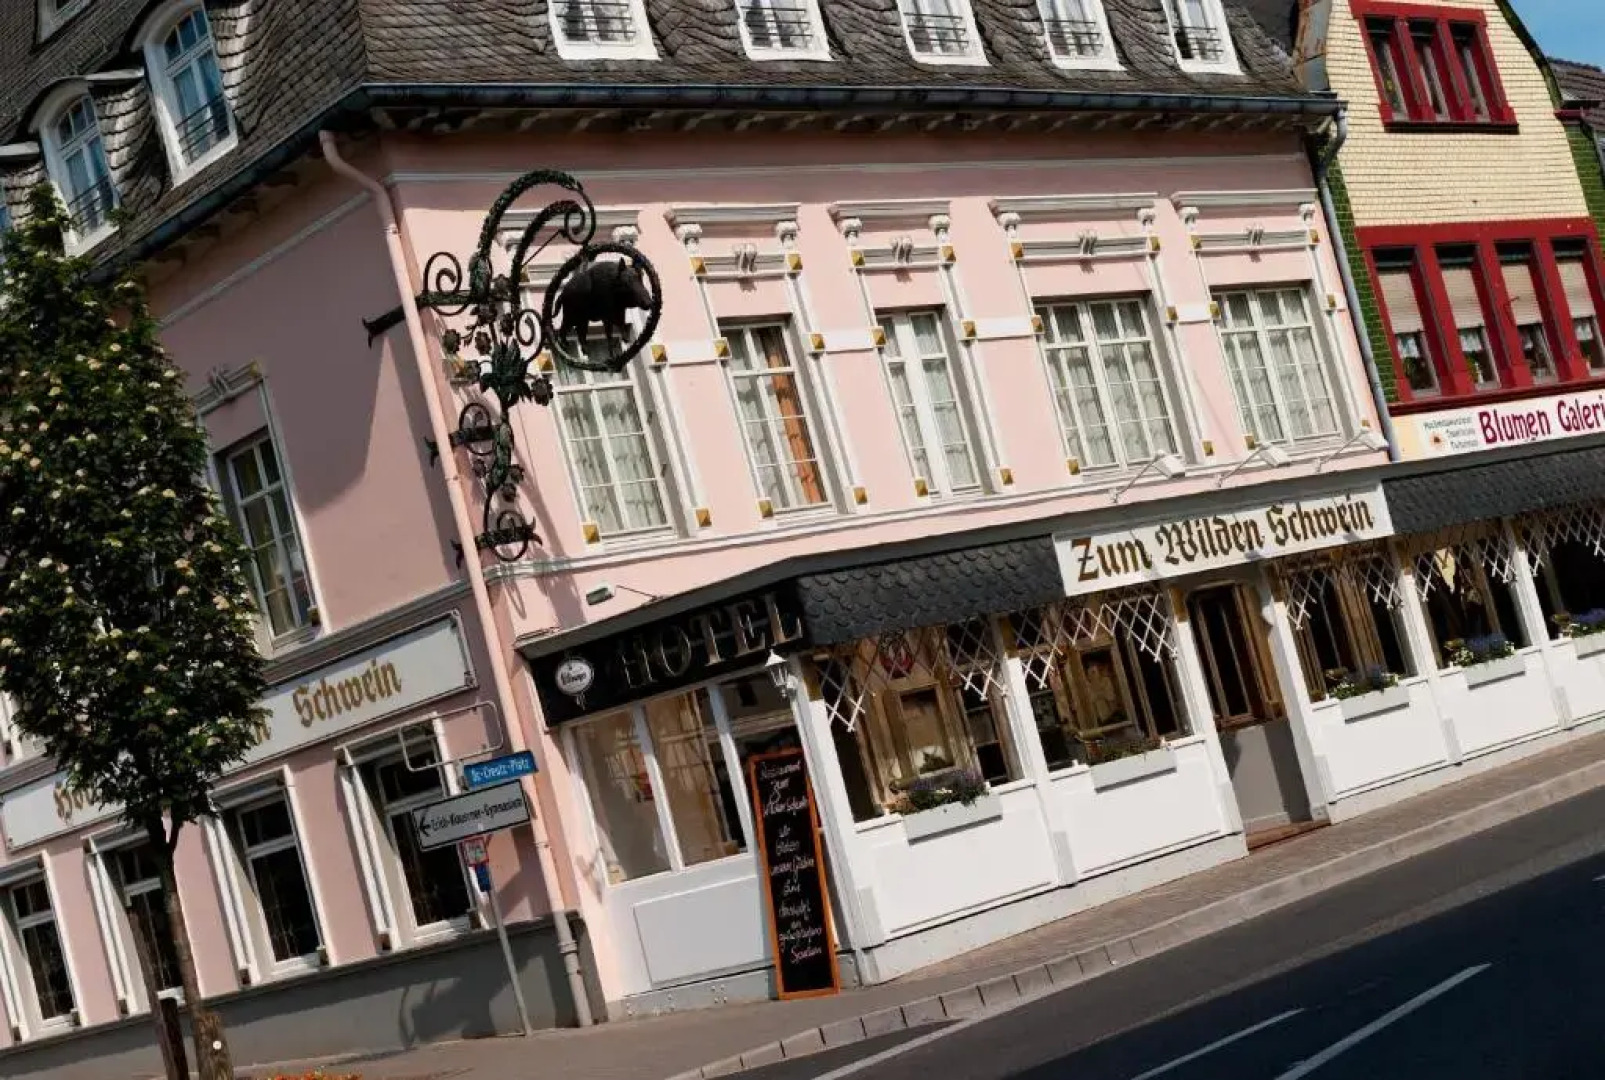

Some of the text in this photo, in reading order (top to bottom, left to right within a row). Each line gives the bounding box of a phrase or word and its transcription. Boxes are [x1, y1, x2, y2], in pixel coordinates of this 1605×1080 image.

[1478, 409, 1551, 445] Blumen
[1071, 494, 1374, 582] Zum Wilden Schwein
[617, 594, 803, 689] HOTEL
[293, 658, 402, 728] Schwein
